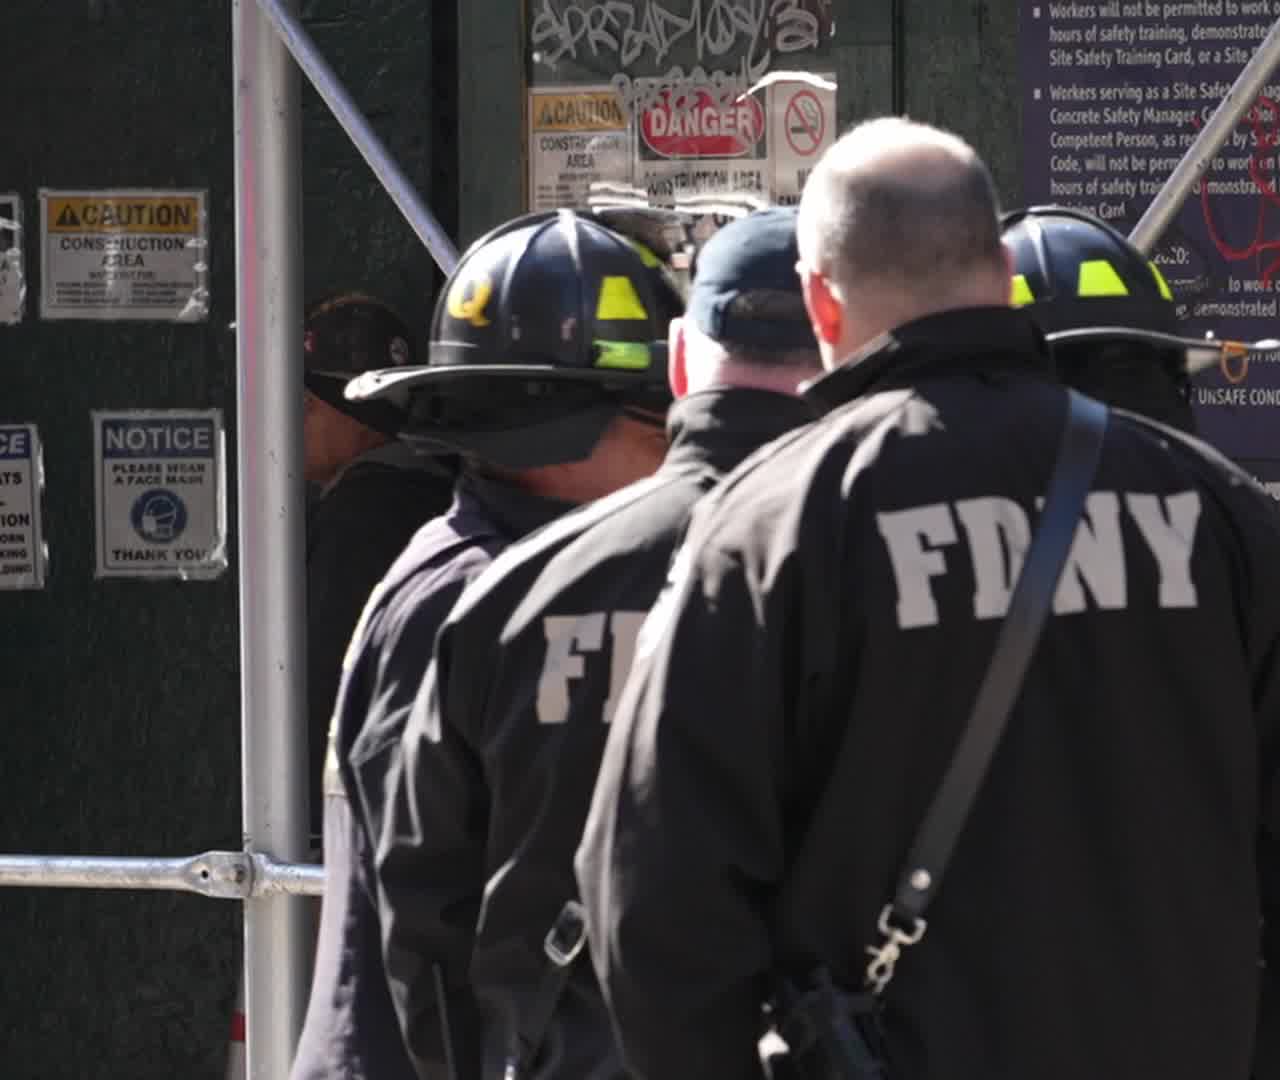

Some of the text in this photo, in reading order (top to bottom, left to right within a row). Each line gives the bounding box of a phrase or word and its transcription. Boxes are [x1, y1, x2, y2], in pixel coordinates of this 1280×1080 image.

[1050, 2, 1096, 18] Workers
[1100, 1, 1120, 17] will
[1123, 1, 1144, 17] not
[1146, 0, 1160, 16] be
[1164, 0, 1223, 19] permitted
[1225, 0, 1239, 16] to
[1242, 0, 1271, 15] work
[1050, 24, 1083, 42] hours
[1085, 24, 1098, 41] of
[1100, 25, 1137, 44] safety
[1139, 24, 1188, 44] training,
[1192, 23, 1267, 40] demonstrate
[1050, 47, 1248, 68] Site Safety Training Card, or a Site
[1050, 84, 1097, 101] Workers
[1100, 85, 1143, 104] serving
[1145, 86, 1159, 99] as
[1162, 86, 1169, 99] a
[1173, 82, 1196, 99] Site
[1200, 81, 1232, 98] Safet
[554, 99, 622, 125] CAUTION
[649, 104, 756, 138] DANGER
[1050, 107, 1099, 125] Concrete
[1103, 106, 1139, 127] Safety
[1050, 131, 1113, 150] Competent
[1116, 130, 1160, 148] Person,
[1162, 133, 1176, 147] as
[1233, 129, 1247, 150] by
[1050, 155, 1081, 172] Code,
[1085, 154, 1106, 171] will
[1108, 155, 1129, 171] not
[1132, 154, 1146, 171] be
[1211, 154, 1225, 171] to
[1050, 177, 1084, 195] hours
[1086, 176, 1099, 194] of
[1102, 176, 1138, 197] safety
[82, 203, 191, 225] CAUTION
[1228, 276, 1242, 293] to
[1199, 388, 1247, 407] UNSAFE
[106, 427, 210, 450] NOTICE
[112, 463, 206, 473] PLEASE WEAR
[114, 475, 123, 486] A
[127, 475, 163, 486] FACE
[112, 550, 207, 561] THANK YOU
[876, 490, 1202, 630] FDNY
